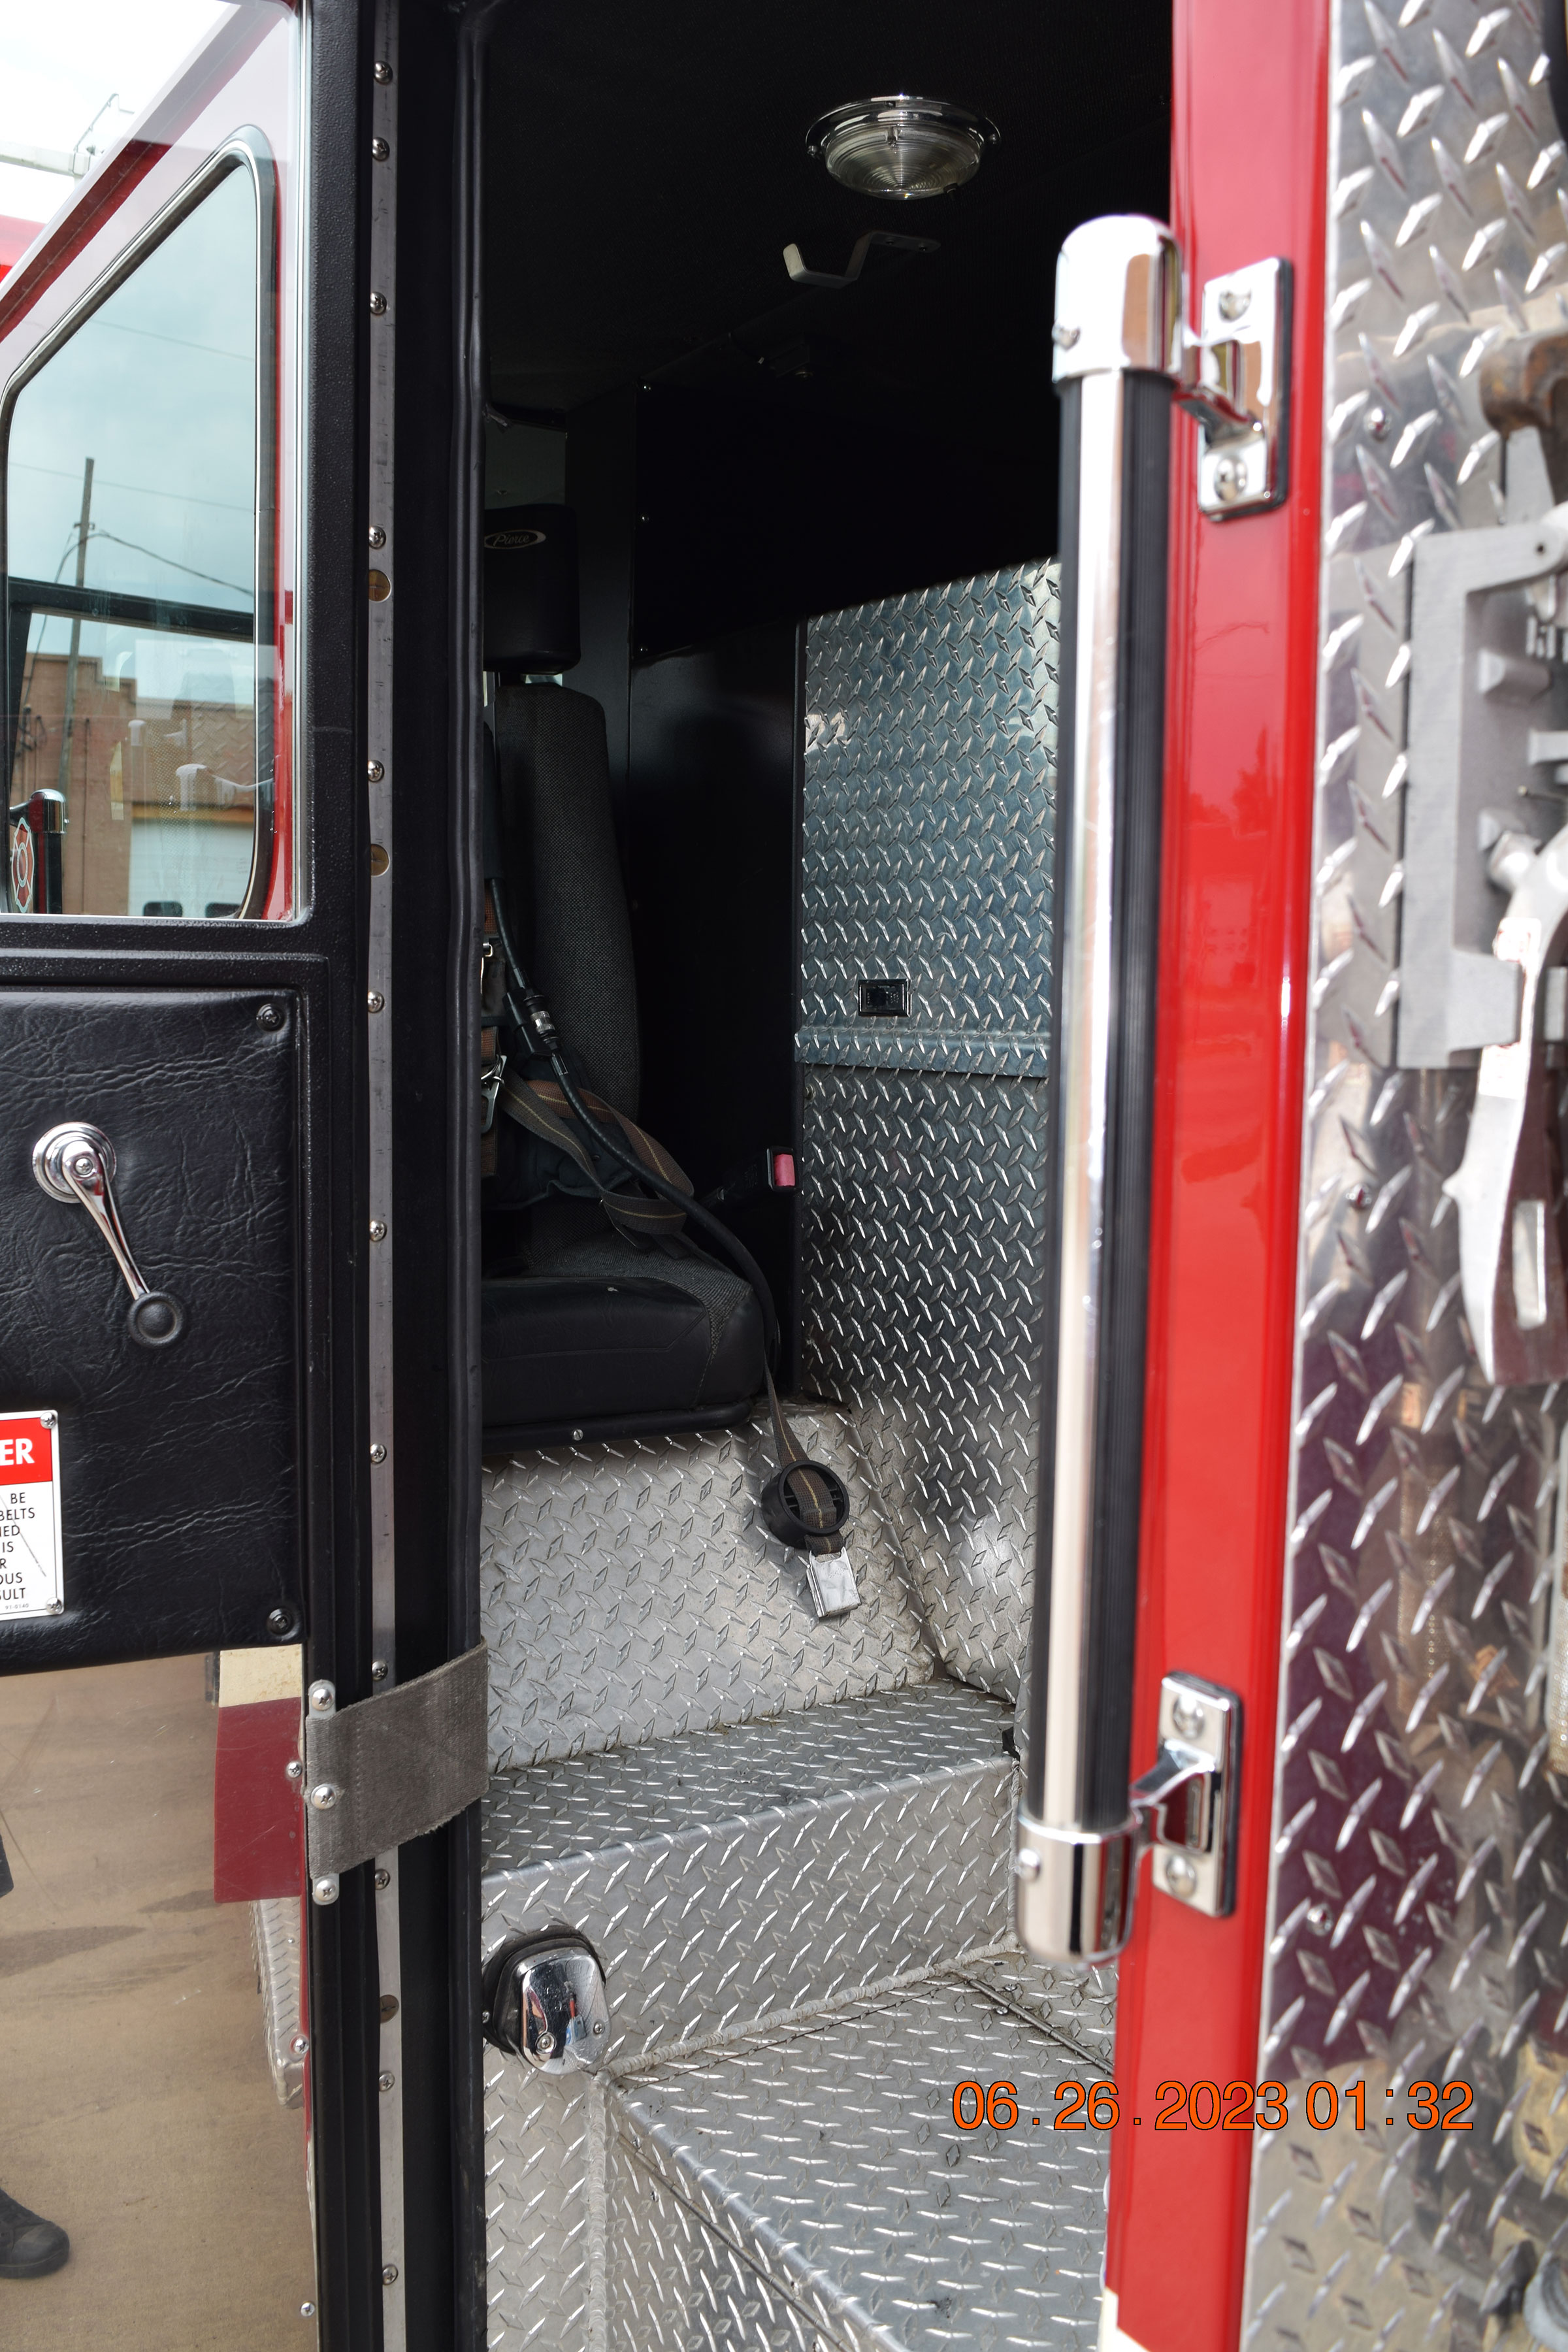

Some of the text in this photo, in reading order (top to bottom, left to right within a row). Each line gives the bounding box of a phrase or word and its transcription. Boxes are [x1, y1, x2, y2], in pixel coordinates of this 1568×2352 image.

[10, 1492, 25, 1505] BE
[0, 1525, 20, 1537] ED
[3, 1541, 14, 1553] IS
[0, 1588, 26, 1600] ULT
